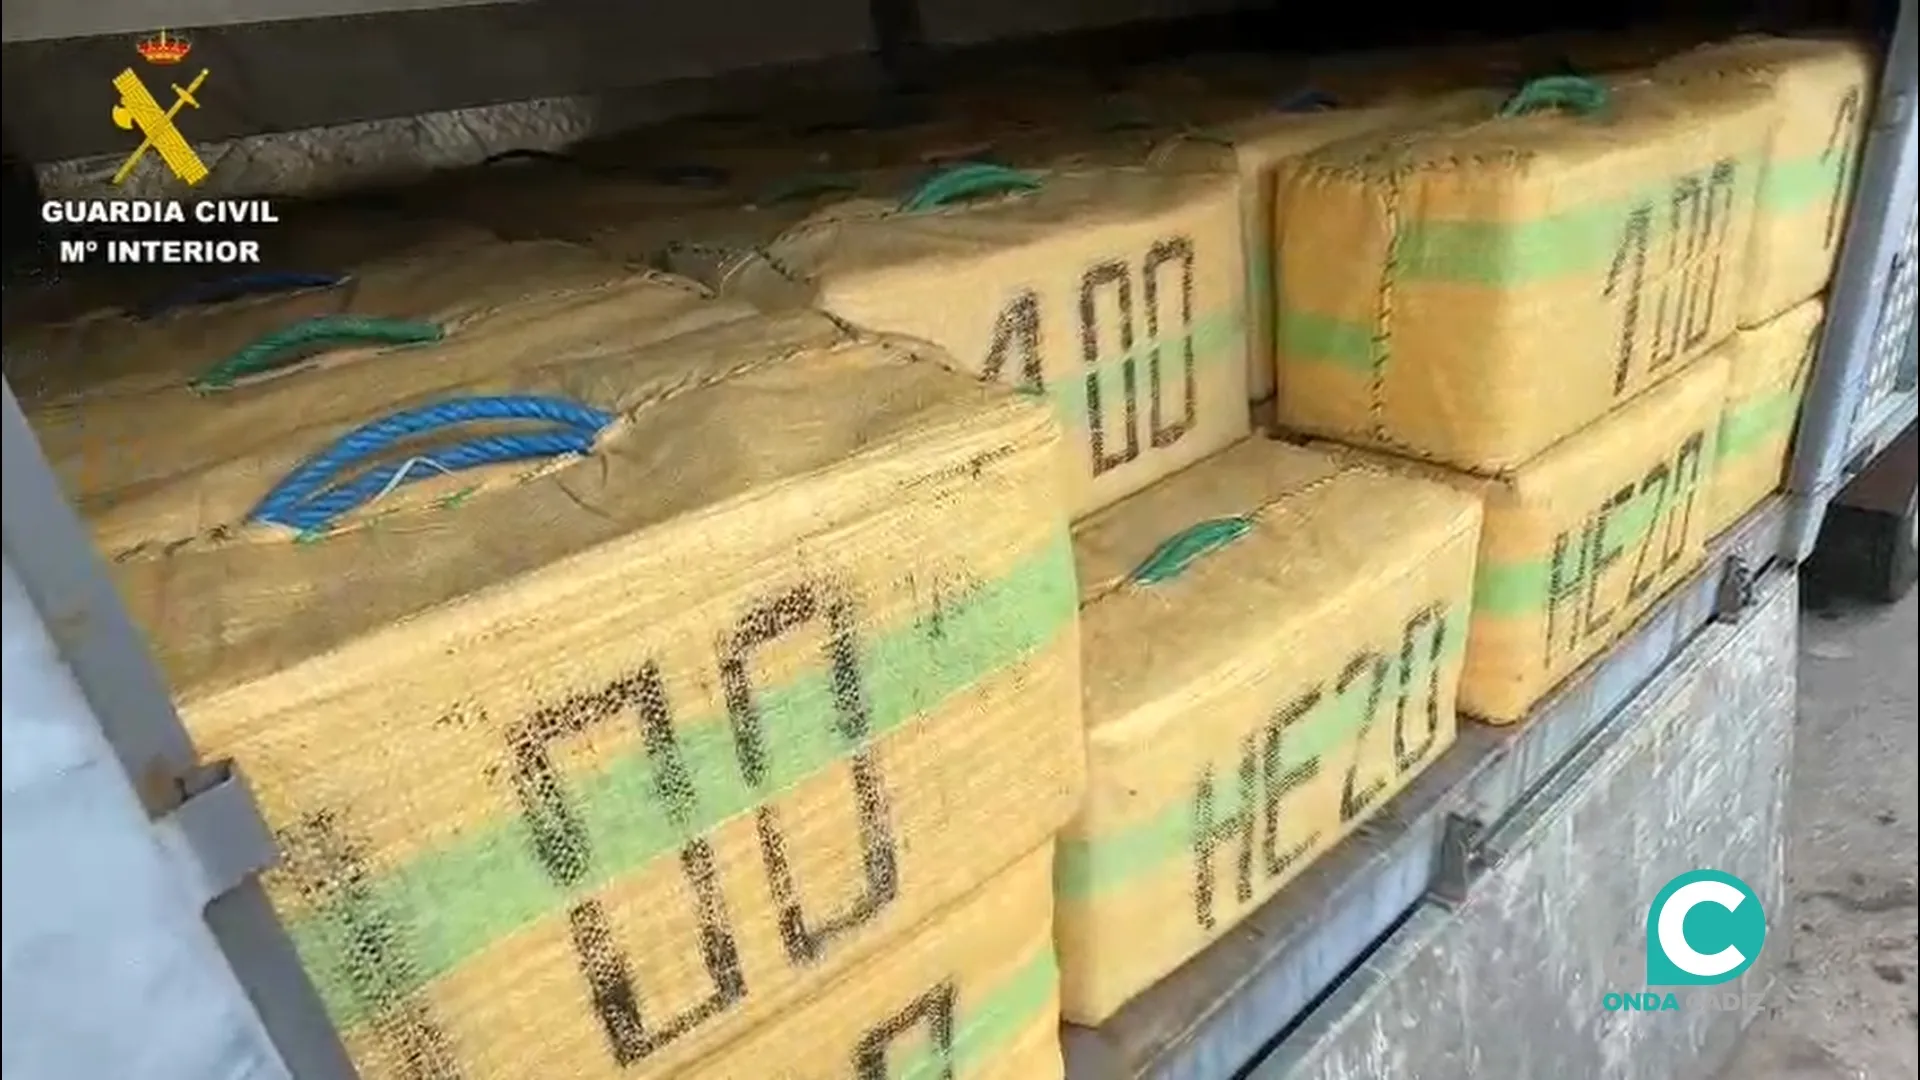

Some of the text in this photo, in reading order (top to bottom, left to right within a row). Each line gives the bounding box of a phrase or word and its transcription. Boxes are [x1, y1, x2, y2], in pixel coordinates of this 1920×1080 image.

[1602, 156, 1735, 397] 100
[1544, 430, 1703, 668] HE20
[1193, 600, 1447, 930] HE20
